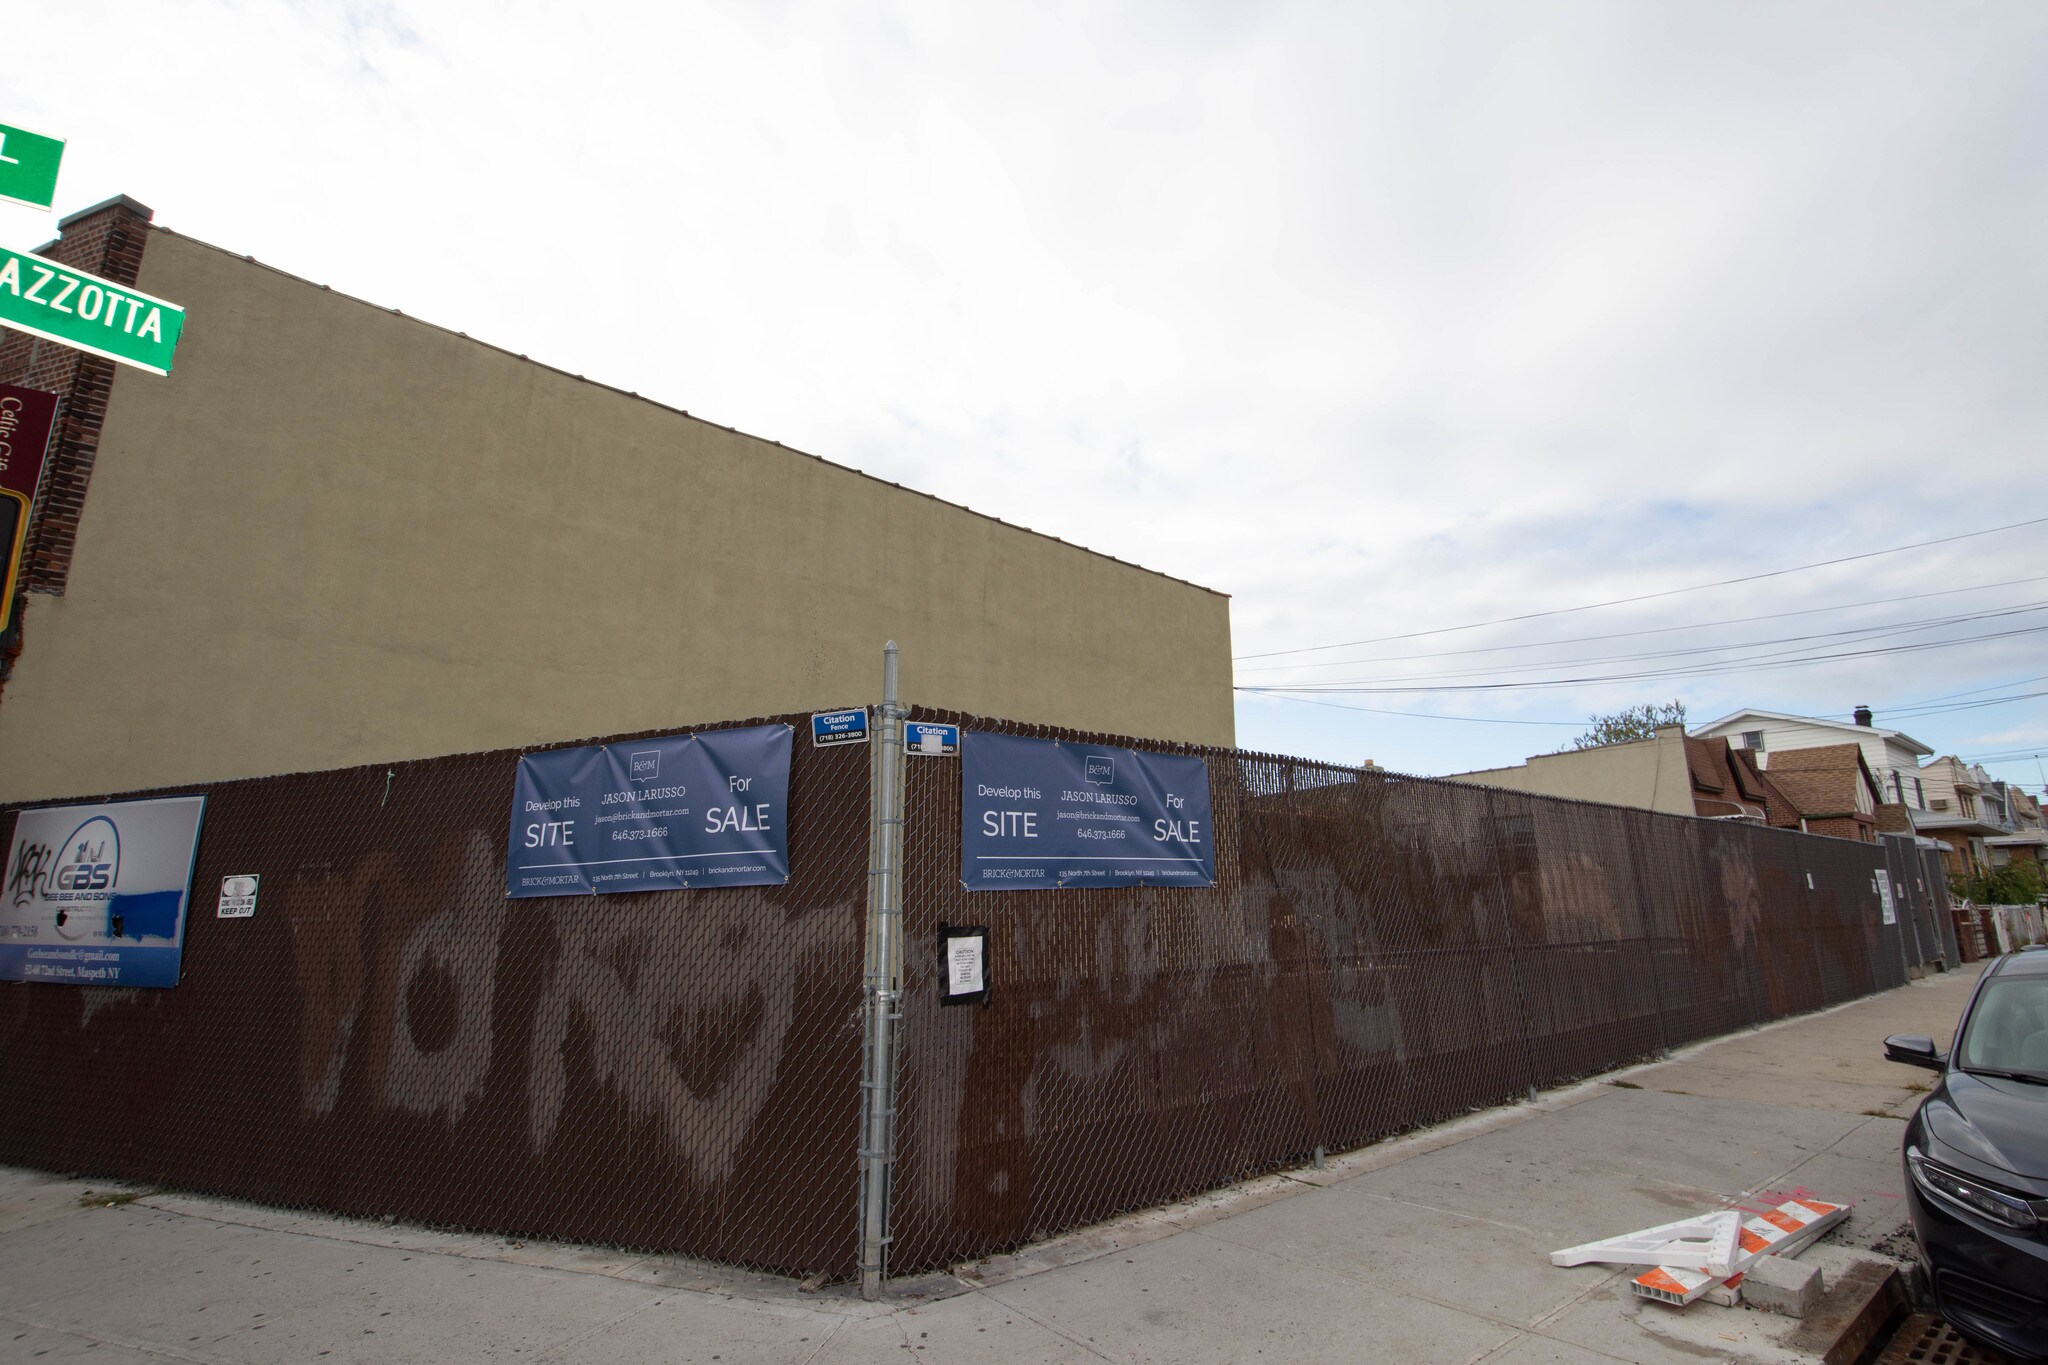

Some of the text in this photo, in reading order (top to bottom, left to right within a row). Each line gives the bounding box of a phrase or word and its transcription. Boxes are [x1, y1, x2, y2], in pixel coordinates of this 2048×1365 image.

[0, 258, 161, 343] AZZOTTA
[823, 714, 855, 725] Citation
[917, 725, 948, 736] Citation
[819, 734, 834, 742] (718)
[633, 760, 655, 771] B&M
[1088, 764, 1111, 775] B&M
[729, 775, 752, 792] For
[601, 786, 686, 804] JASON LARUSSO
[978, 784, 1041, 800] Develop this
[1061, 791, 1137, 805] JASON LARUSSO
[525, 796, 581, 812] Develop this
[1166, 793, 1184, 808] For
[594, 808, 689, 825] jason@brickandmortar.com
[705, 803, 770, 833] SALE
[1057, 810, 1140, 822] jason@brickandmortar.com
[983, 810, 1038, 837] SITE
[1153, 818, 1200, 842] SALE
[525, 821, 574, 848] SITE
[612, 827, 668, 841] 646.373.1666
[1077, 828, 1126, 840] 646.373.1666
[57, 863, 112, 890] GBS
[613, 873, 622, 881] 7th
[708, 864, 766, 874] brickandmortar.com
[982, 869, 1045, 878] BRICK&MORTAR
[522, 875, 579, 886] BRICK&MORTAR
[59, 893, 74, 901] BEE
[75, 892, 92, 900] AND
[77, 966, 106, 980] Maspeth
[107, 967, 121, 978] NY
